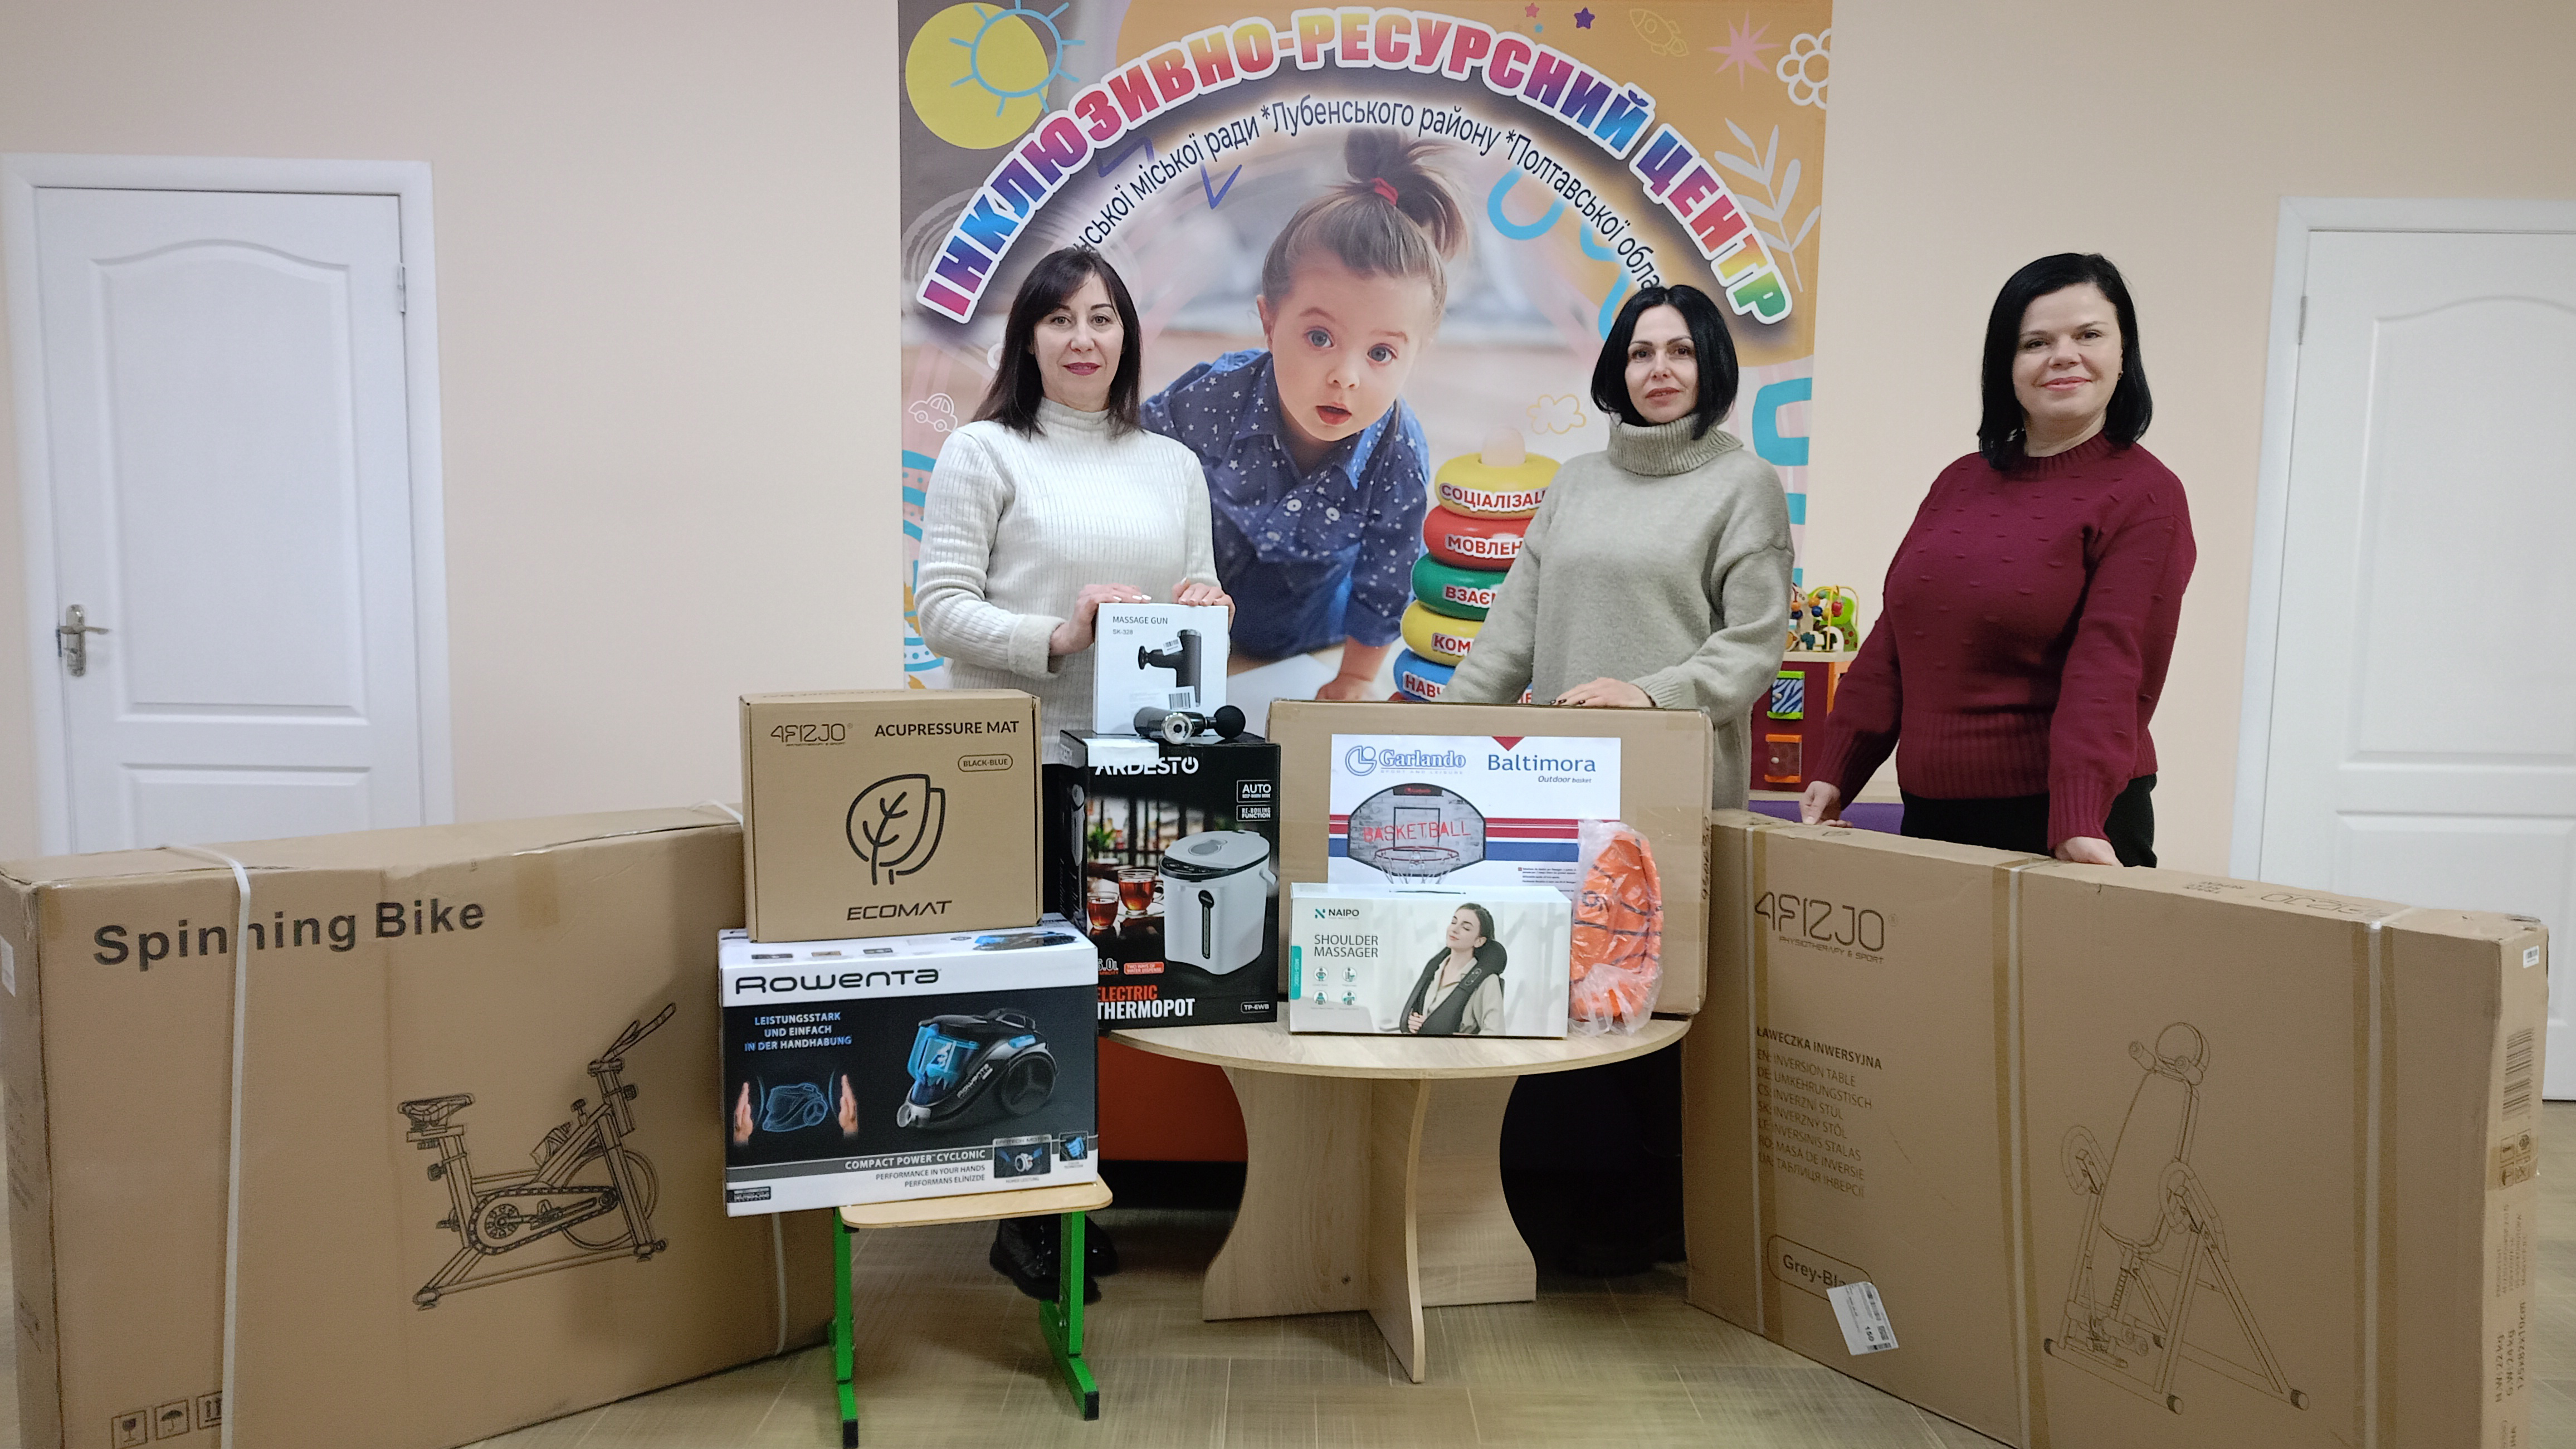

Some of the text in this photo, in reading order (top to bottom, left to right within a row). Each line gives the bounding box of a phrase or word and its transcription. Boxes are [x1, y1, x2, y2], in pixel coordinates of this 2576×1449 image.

[920, 11, 1788, 320] ІНКЛЮЗИВНО-РЕСУРСНИЙ ЦЕНТР
[1074, 188, 1135, 248] нської
[1130, 135, 1204, 201] міської
[1207, 114, 1261, 163] ради
[1418, 106, 1502, 157] району
[1616, 236, 1661, 292] обла
[1441, 484, 1546, 509] СОЦІАЛІЗАЦ
[1448, 536, 1523, 555] МОВЛЕН
[1446, 586, 1496, 606] ВЗАЄ
[1113, 616, 1168, 625] MASSAGE GUN
[1433, 634, 1471, 654] КОМ
[1405, 674, 1441, 698] НАВ
[770, 723, 846, 743] 4FIZJO
[874, 720, 1019, 737] ACUPRESSURE MAT
[963, 758, 1008, 768] BLACK-BLUE
[1379, 749, 1466, 768] Garlando
[1488, 754, 1596, 772] Baltimora
[1242, 783, 1272, 793] AUTO
[1363, 820, 1471, 843] BASKETBALL
[846, 900, 953, 921] ECOMAT
[1328, 909, 1360, 917] NAIPO
[1754, 891, 1885, 953] 4FIZJO
[92, 895, 486, 973] Spinning Bike
[1314, 934, 1379, 946] SHOULDER
[1314, 946, 1379, 958] MASSAGER
[1855, 951, 1885, 964] SPORT
[1097, 984, 1158, 1002] ELECTRIC
[754, 1012, 841, 1026] LEISTUNGSSTARK
[1096, 998, 1196, 1021] THERMOPOT
[764, 1025, 832, 1038] UND EINFACH
[744, 1035, 852, 1052] IN DER HANDHABUNG
[1813, 1041, 1882, 1070] INWERSYJNA
[1773, 1053, 1824, 1079] INVERSION
[1827, 1068, 1856, 1087] TABLE
[1774, 1070, 1872, 1110] UMKEHRUNGSTISCH
[845, 1158, 895, 1170] COMPACT
[936, 1149, 986, 1163] CYCLONIC
[1806, 1149, 1819, 1165] DE
[876, 1168, 929, 1180] PERFORMANCE
[939, 1167, 959, 1175] YOUR
[960, 1164, 985, 1173] HANDS
[904, 1177, 953, 1188] PERFORMANS
[1783, 1254, 1847, 1289] Grey-Bla
